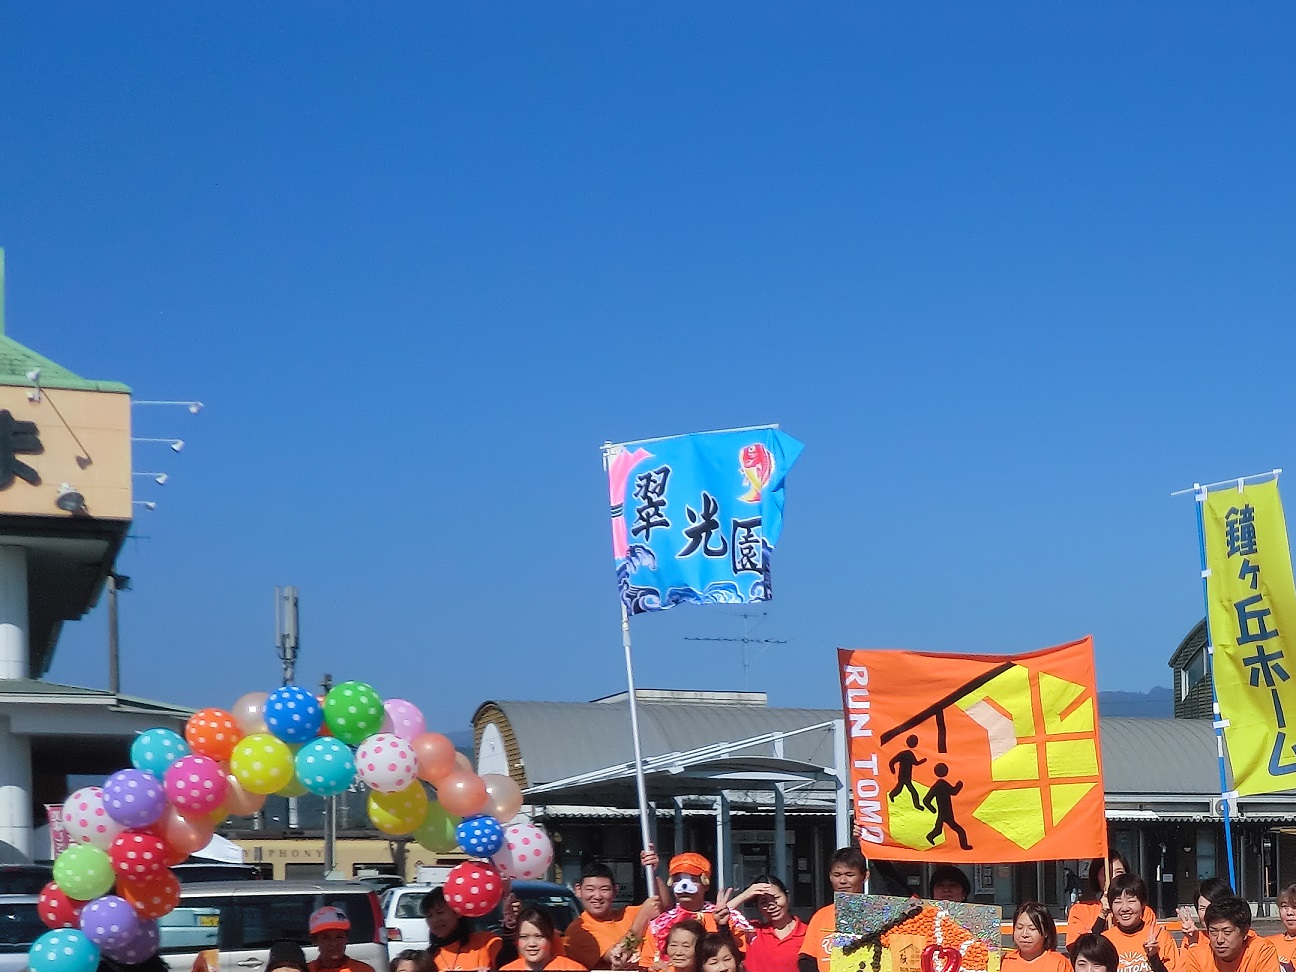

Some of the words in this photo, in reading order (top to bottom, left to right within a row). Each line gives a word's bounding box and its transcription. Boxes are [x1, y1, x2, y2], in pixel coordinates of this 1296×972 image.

[631, 465, 764, 575] 翠光園
[844, 663, 871, 738] RUN
